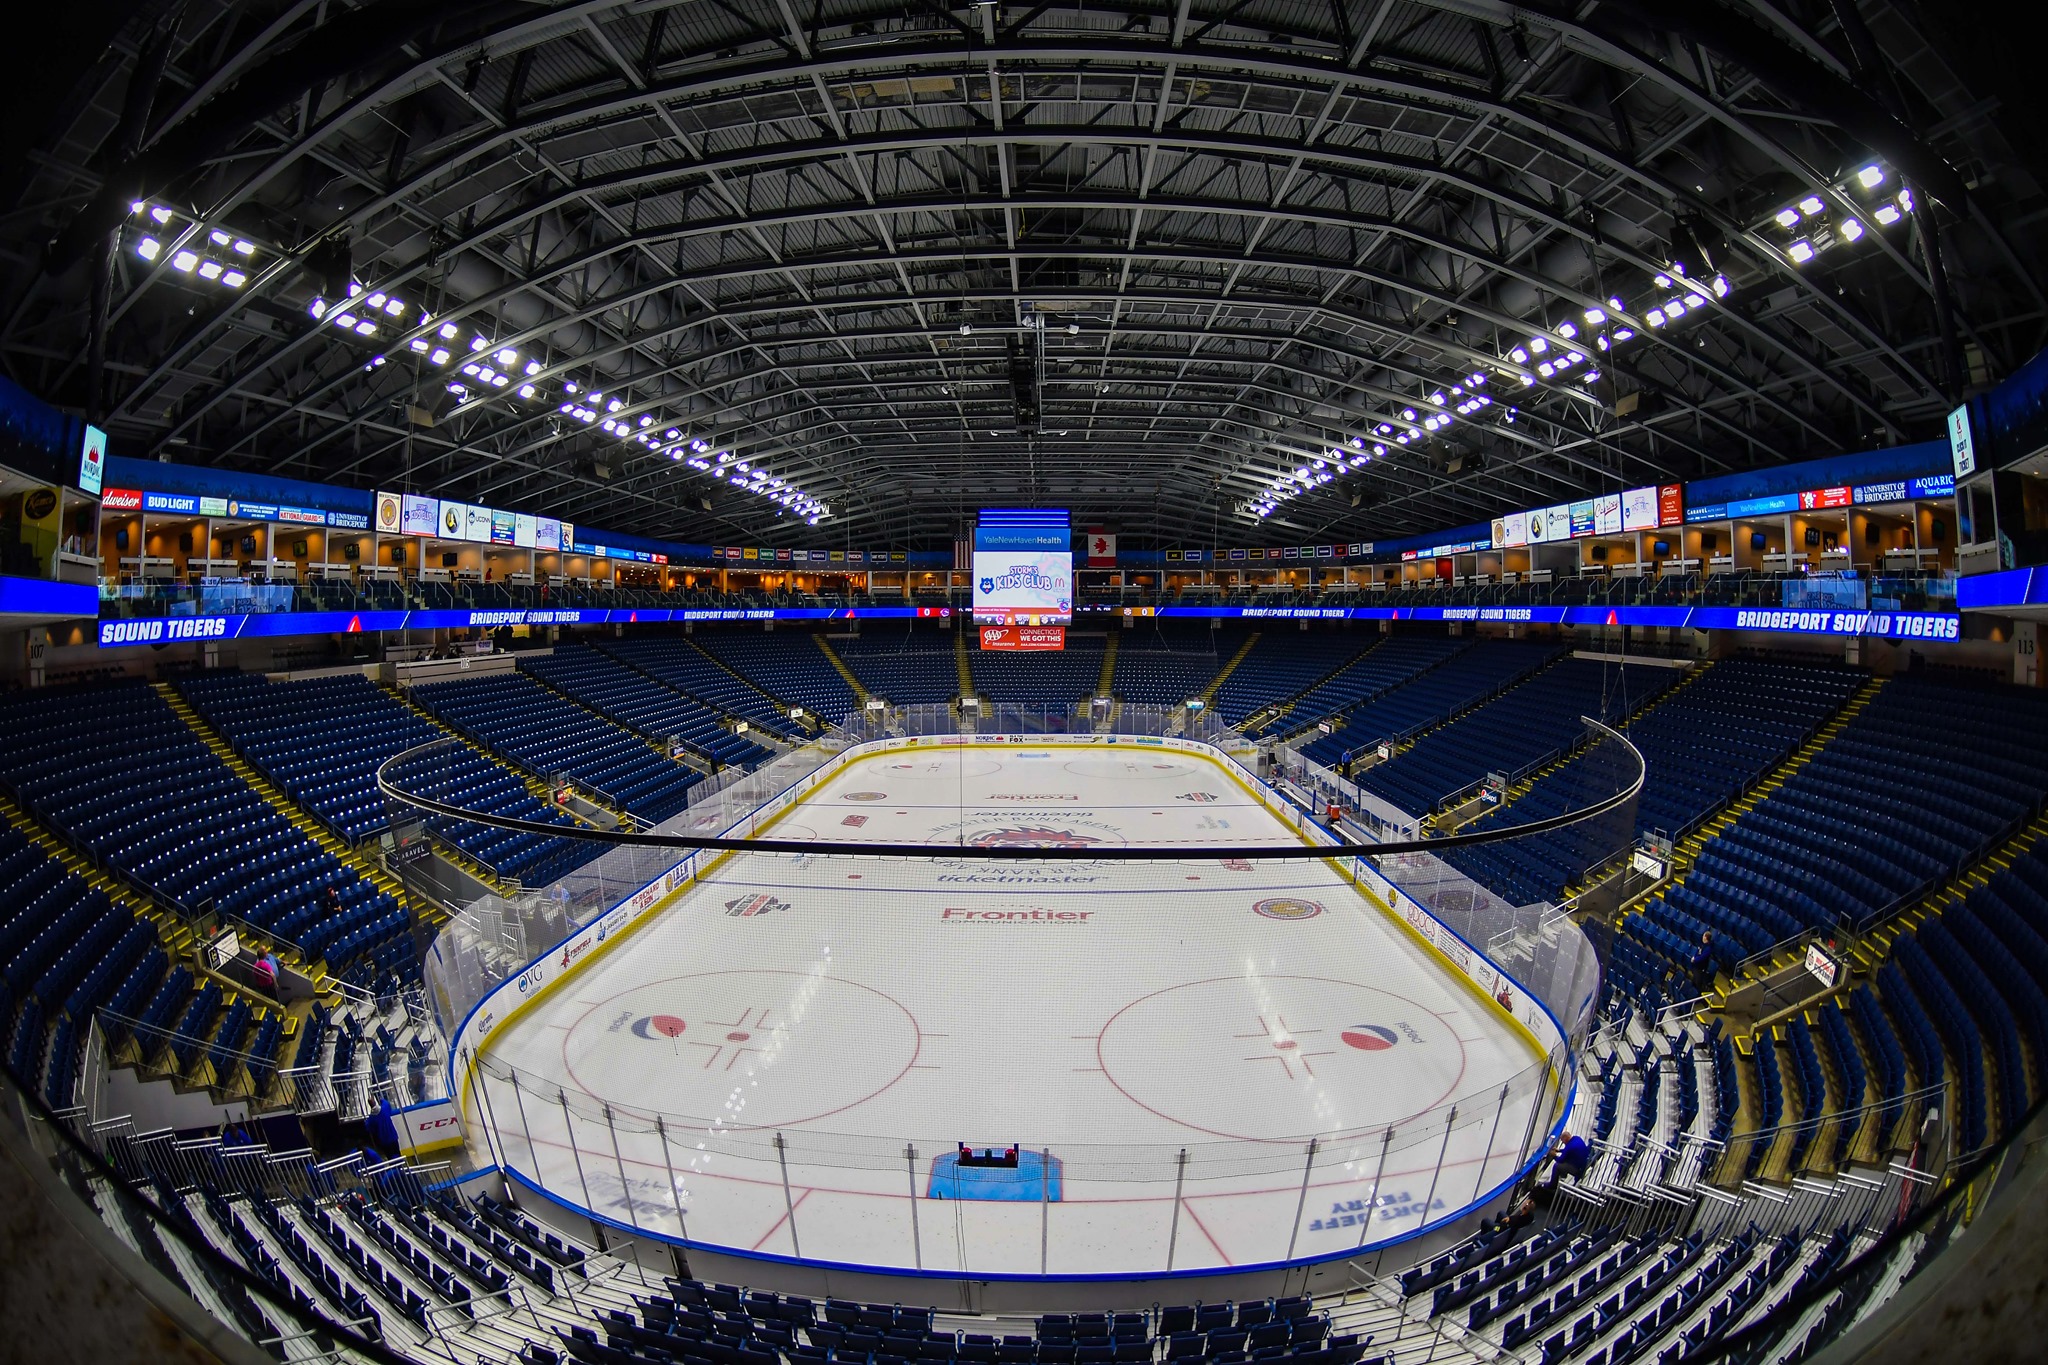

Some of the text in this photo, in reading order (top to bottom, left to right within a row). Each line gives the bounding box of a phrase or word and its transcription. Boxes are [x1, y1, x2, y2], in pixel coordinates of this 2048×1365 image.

[1864, 482, 1906, 494] UNIVERSITY OF
[102, 489, 140, 508] dweiser
[1864, 490, 1906, 502] BRIDGEPORT
[148, 496, 166, 508] BUD
[168, 499, 194, 511] LIGHT
[280, 511, 318, 522] NATIONAL GUARD
[336, 512, 361, 520] UNIVERSITY
[336, 520, 368, 528] BRIDGEPORT
[984, 536, 1062, 544] YaleNewHavenHealth
[1009, 566, 1038, 575] STORM'S
[996, 574, 1052, 590] KIDS CLUB
[470, 611, 580, 624] BRIDGEPORT SOUND TIGERS
[684, 610, 774, 619] BRIDGEPORT SOUND TIGERS
[924, 608, 930, 616] 0
[1142, 608, 1148, 616] 0
[1242, 608, 1292, 616] BRIDGEPORT
[1322, 609, 1344, 617] TIGERS
[1443, 608, 1532, 620] BRIDGEPORT SOUND TIGERS
[102, 618, 226, 643] SOUND TIGERS
[1736, 611, 1958, 638] BRIDGEPORT SOUND TIGERS
[30, 645, 44, 660] 107
[2018, 640, 2034, 655] 113
[985, 793, 1078, 802] Frontier
[927, 817, 998, 832] WEBSTER
[1070, 819, 1124, 832] ARENA
[402, 845, 425, 860] ARAVEL
[937, 874, 1101, 883] ticketmaster
[639, 882, 660, 902] RICHARD
[644, 895, 654, 906] SON
[942, 907, 1095, 920] Frontier
[518, 964, 543, 992] OVG
[478, 1012, 494, 1034] Corona
[483, 1024, 493, 1036] Extra
[1309, 1198, 1446, 1232] PORT JEFF
